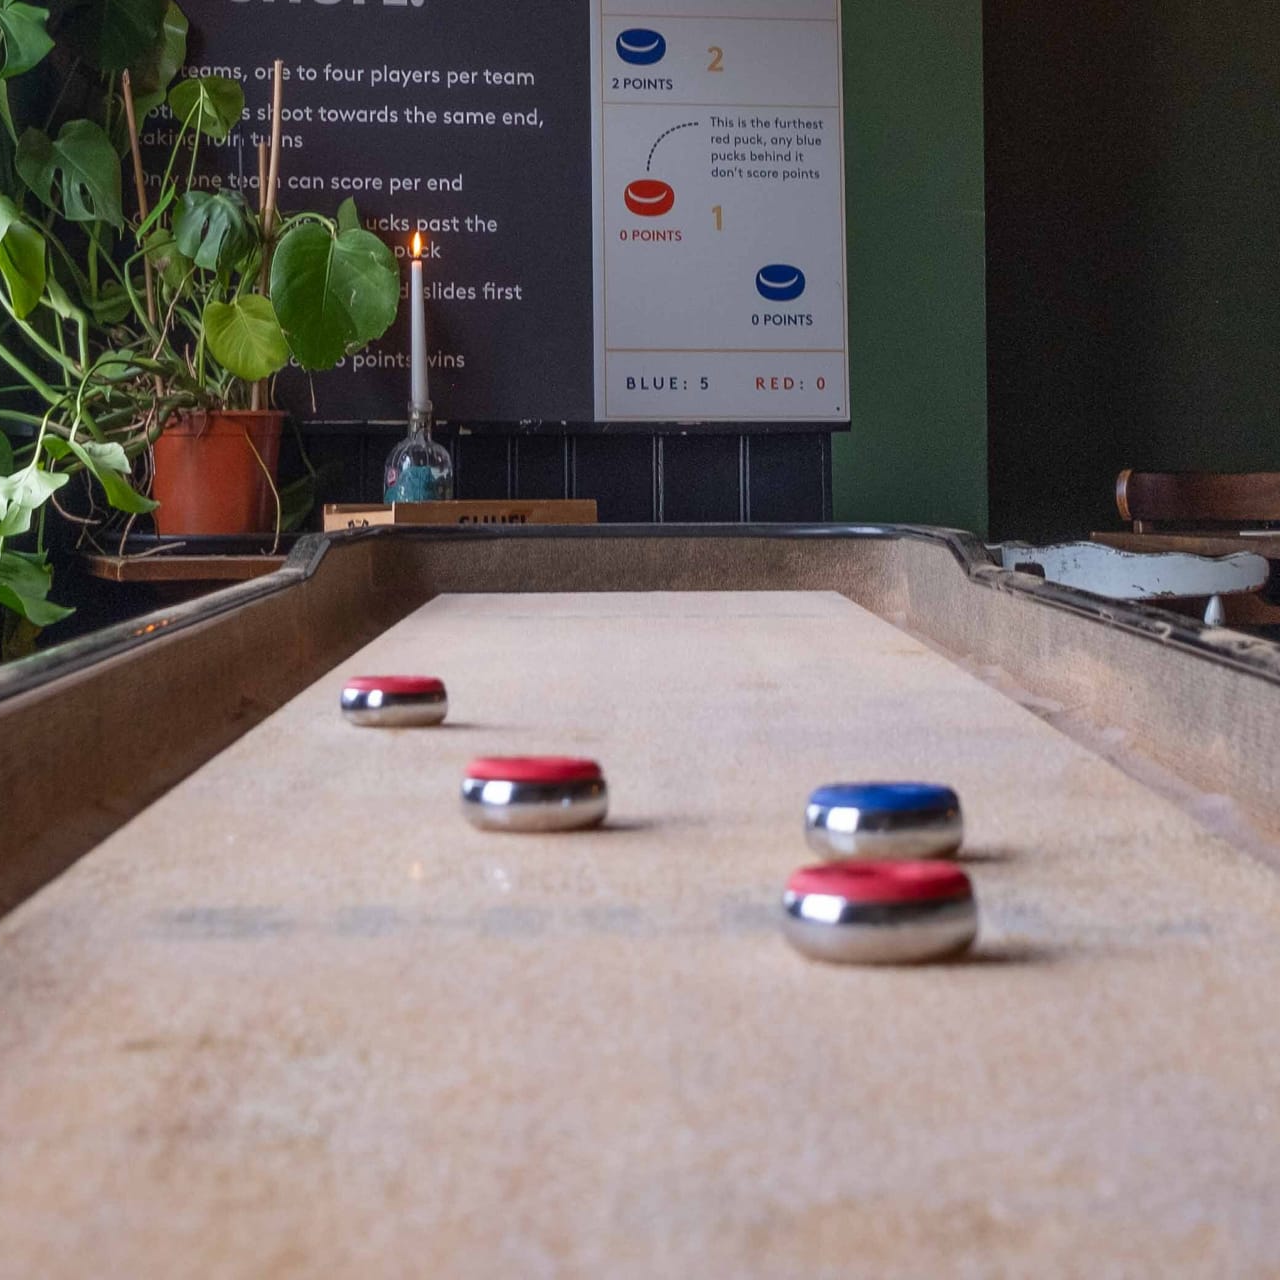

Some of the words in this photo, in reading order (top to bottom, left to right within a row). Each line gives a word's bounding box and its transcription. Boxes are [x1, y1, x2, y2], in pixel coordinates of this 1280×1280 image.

[707, 46, 724, 72] 2
[297, 66, 317, 81] to
[323, 63, 364, 82] four
[371, 64, 440, 88] players
[447, 69, 478, 88] per
[483, 69, 535, 86] team
[612, 78, 620, 90] 2
[623, 78, 673, 91] POINTS
[318, 104, 398, 123] towards
[404, 105, 437, 124] the
[443, 110, 496, 125] same
[502, 107, 543, 128] end,
[710, 116, 734, 128] This
[738, 117, 747, 128] is
[750, 117, 771, 129] the
[774, 117, 824, 130] furthest
[710, 133, 730, 145] red
[734, 133, 767, 148] puck,
[770, 136, 792, 148] any
[796, 133, 822, 146] blue
[711, 150, 747, 165] pucks
[750, 150, 791, 163] behind
[795, 150, 804, 163] it
[711, 167, 744, 179] don't
[746, 169, 779, 180] score
[782, 167, 820, 181] points
[288, 175, 324, 190] can
[331, 174, 382, 190] score
[390, 176, 421, 195] per
[427, 173, 463, 191] end
[366, 213, 410, 231] ucks
[417, 215, 459, 232] past
[465, 214, 497, 232] the
[712, 205, 723, 230] 1
[620, 229, 627, 241] 0
[632, 229, 682, 241] POINTS
[423, 282, 476, 300] slides
[482, 282, 522, 300] first
[751, 314, 759, 326] 0
[764, 314, 813, 326] POINTS
[626, 376, 687, 390] BLUE:
[701, 376, 709, 390] 5
[755, 376, 804, 390] RED:
[817, 376, 825, 390] 0
